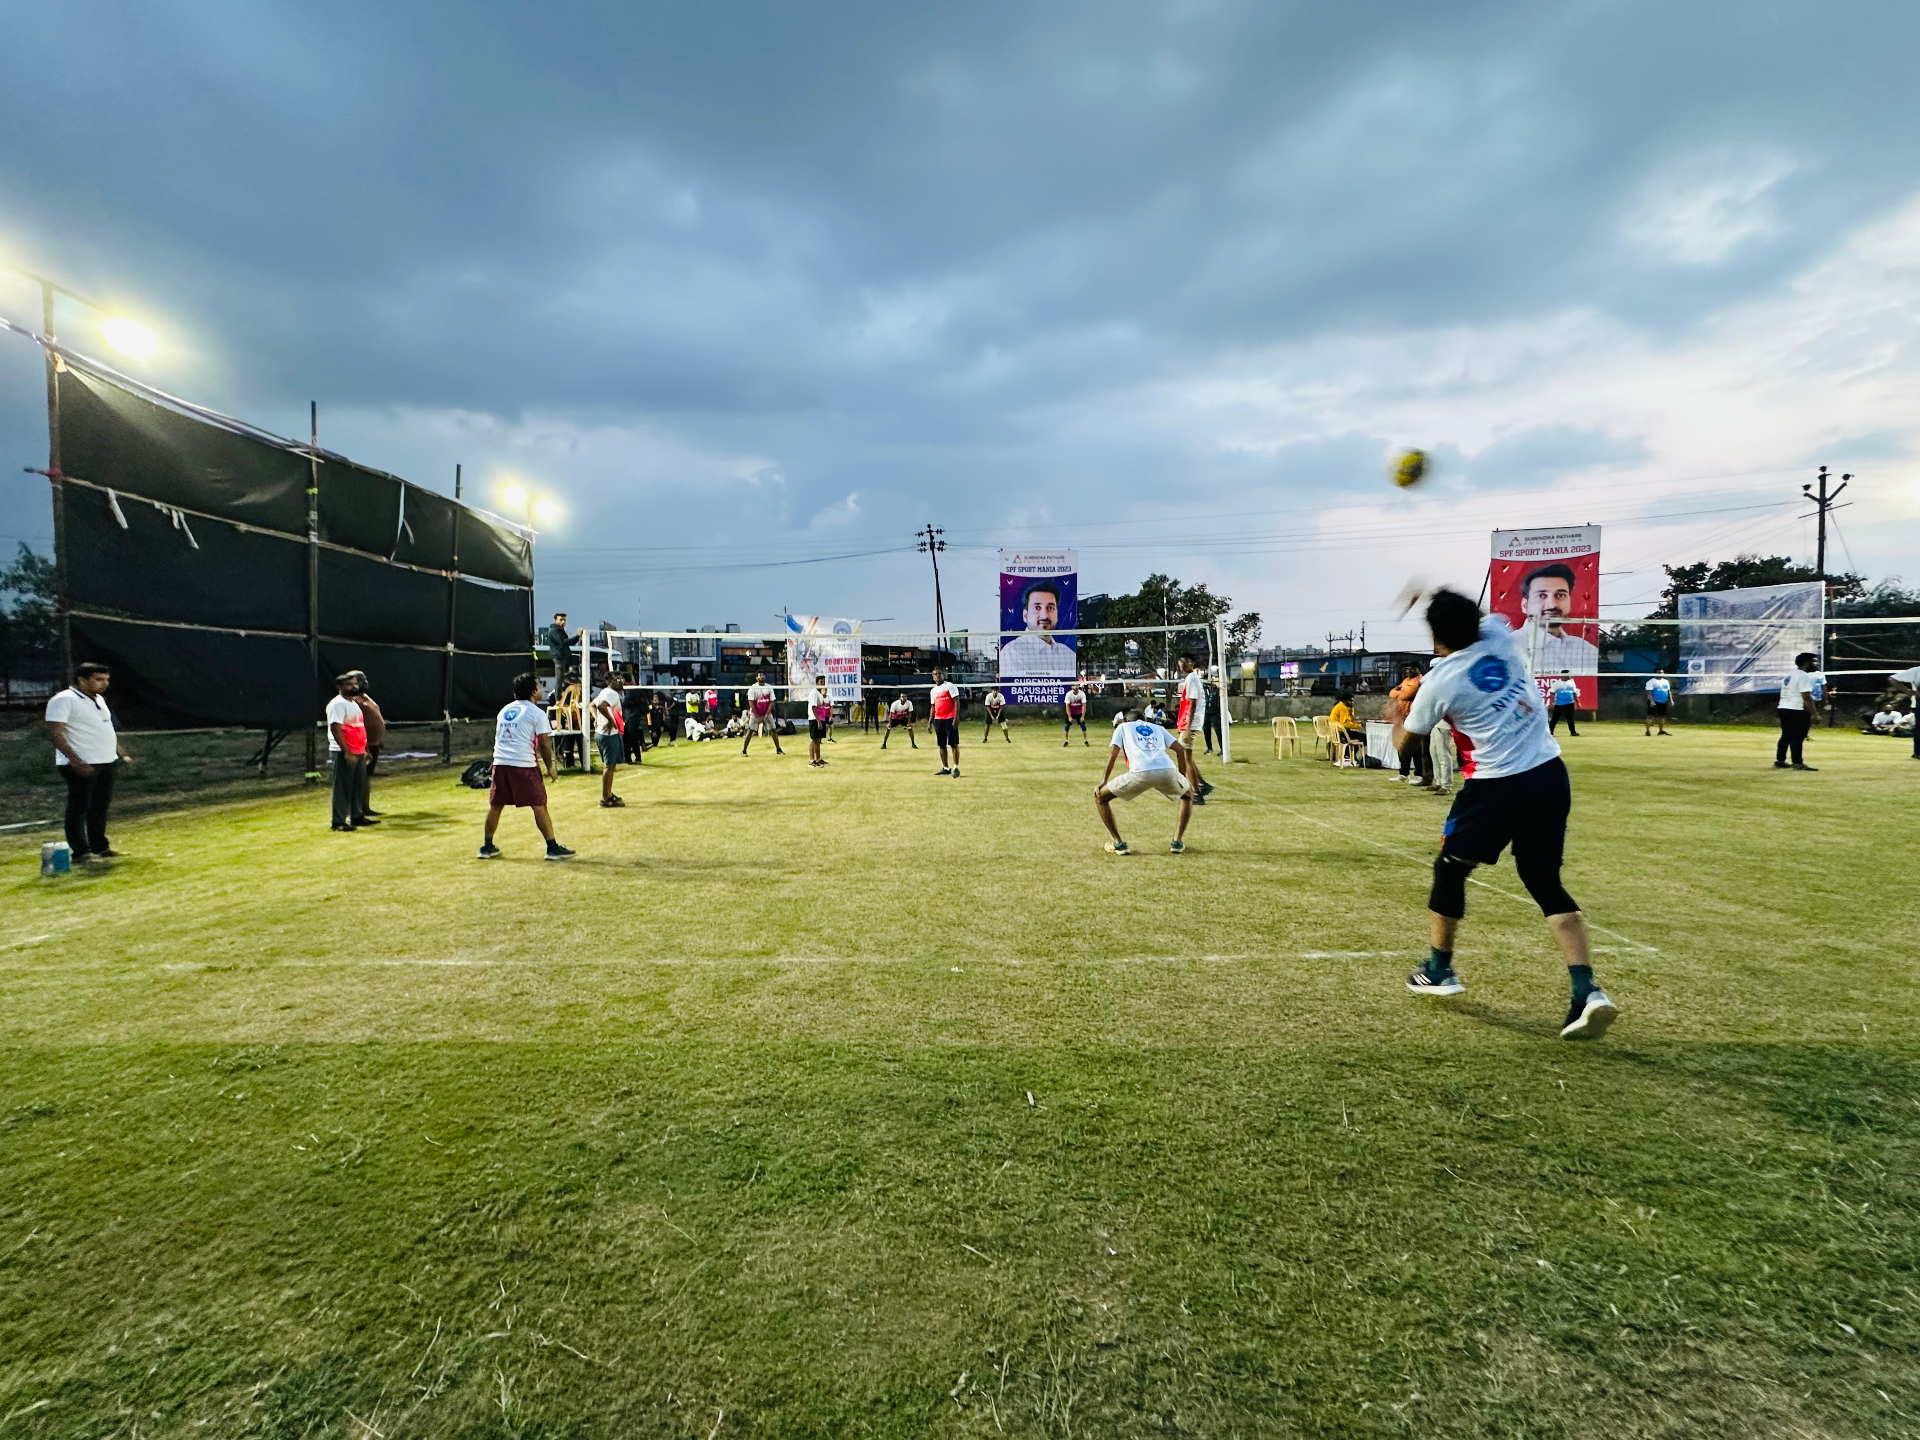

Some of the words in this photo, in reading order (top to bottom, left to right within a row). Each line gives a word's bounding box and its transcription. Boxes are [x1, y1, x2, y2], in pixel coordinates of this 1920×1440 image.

[1516, 548, 1541, 556] SPORT
[1542, 546, 1569, 555] MANIA
[1571, 545, 1592, 553] 2023
[825, 658, 832, 666] GO
[844, 657, 860, 665] THERE
[827, 674, 842, 684] ALL
[842, 673, 857, 684] THE
[832, 687, 855, 697] BEST!
[1011, 686, 1065, 695] BAPUSAHEB
[1017, 694, 1059, 703] PATHARE
